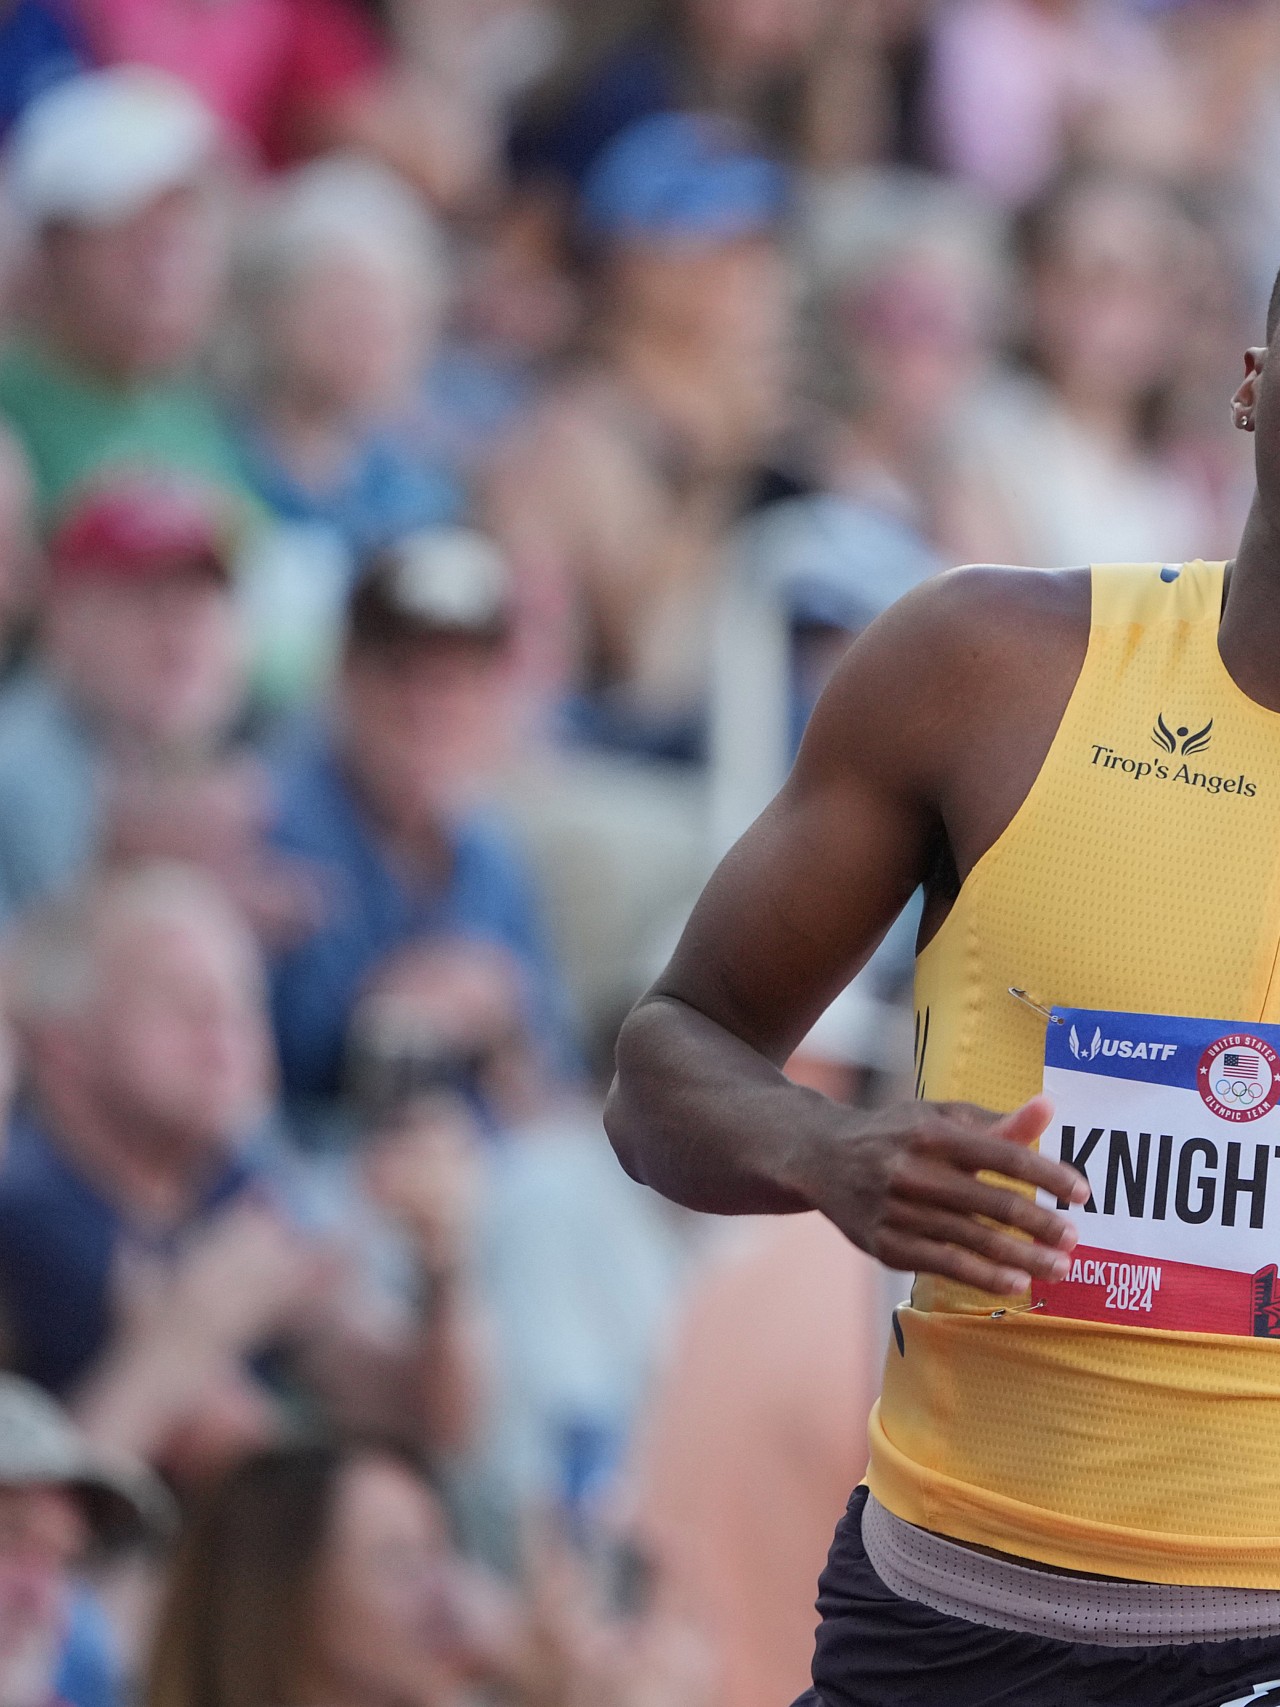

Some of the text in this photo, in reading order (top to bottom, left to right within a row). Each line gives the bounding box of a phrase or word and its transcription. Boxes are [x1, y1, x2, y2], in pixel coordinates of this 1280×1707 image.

[1091, 744, 1258, 798] Tirop's Angels
[1101, 1038, 1178, 1061] USATF
[1207, 1036, 1276, 1062] UNITED STATES
[1205, 1095, 1272, 1120] OLYMPIC TEAM
[1063, 1258, 1162, 1291] ACKTOWN
[1105, 1284, 1153, 1312] 2024
